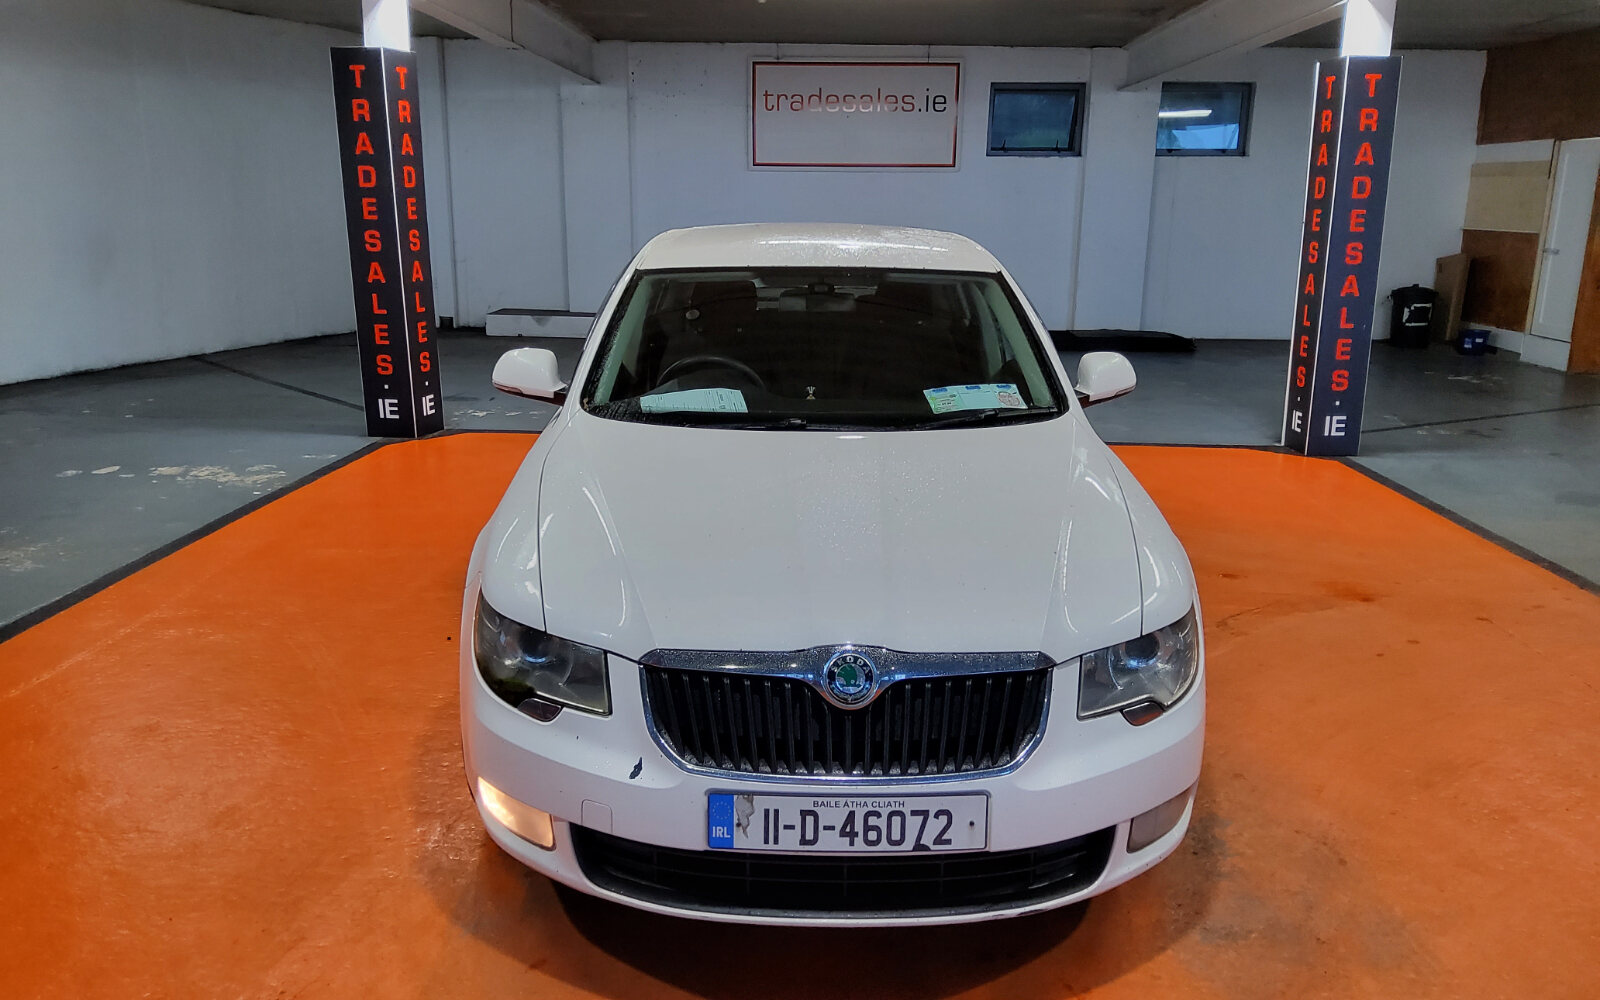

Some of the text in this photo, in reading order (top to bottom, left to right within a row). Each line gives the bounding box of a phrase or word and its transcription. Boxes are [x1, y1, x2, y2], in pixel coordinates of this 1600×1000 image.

[762, 87, 947, 113] tradesales.ie
[812, 800, 842, 808] BAILE
[871, 800, 905, 808] CLIATH
[712, 825, 731, 839] IRL
[763, 808, 953, 848] 11-D-46072
